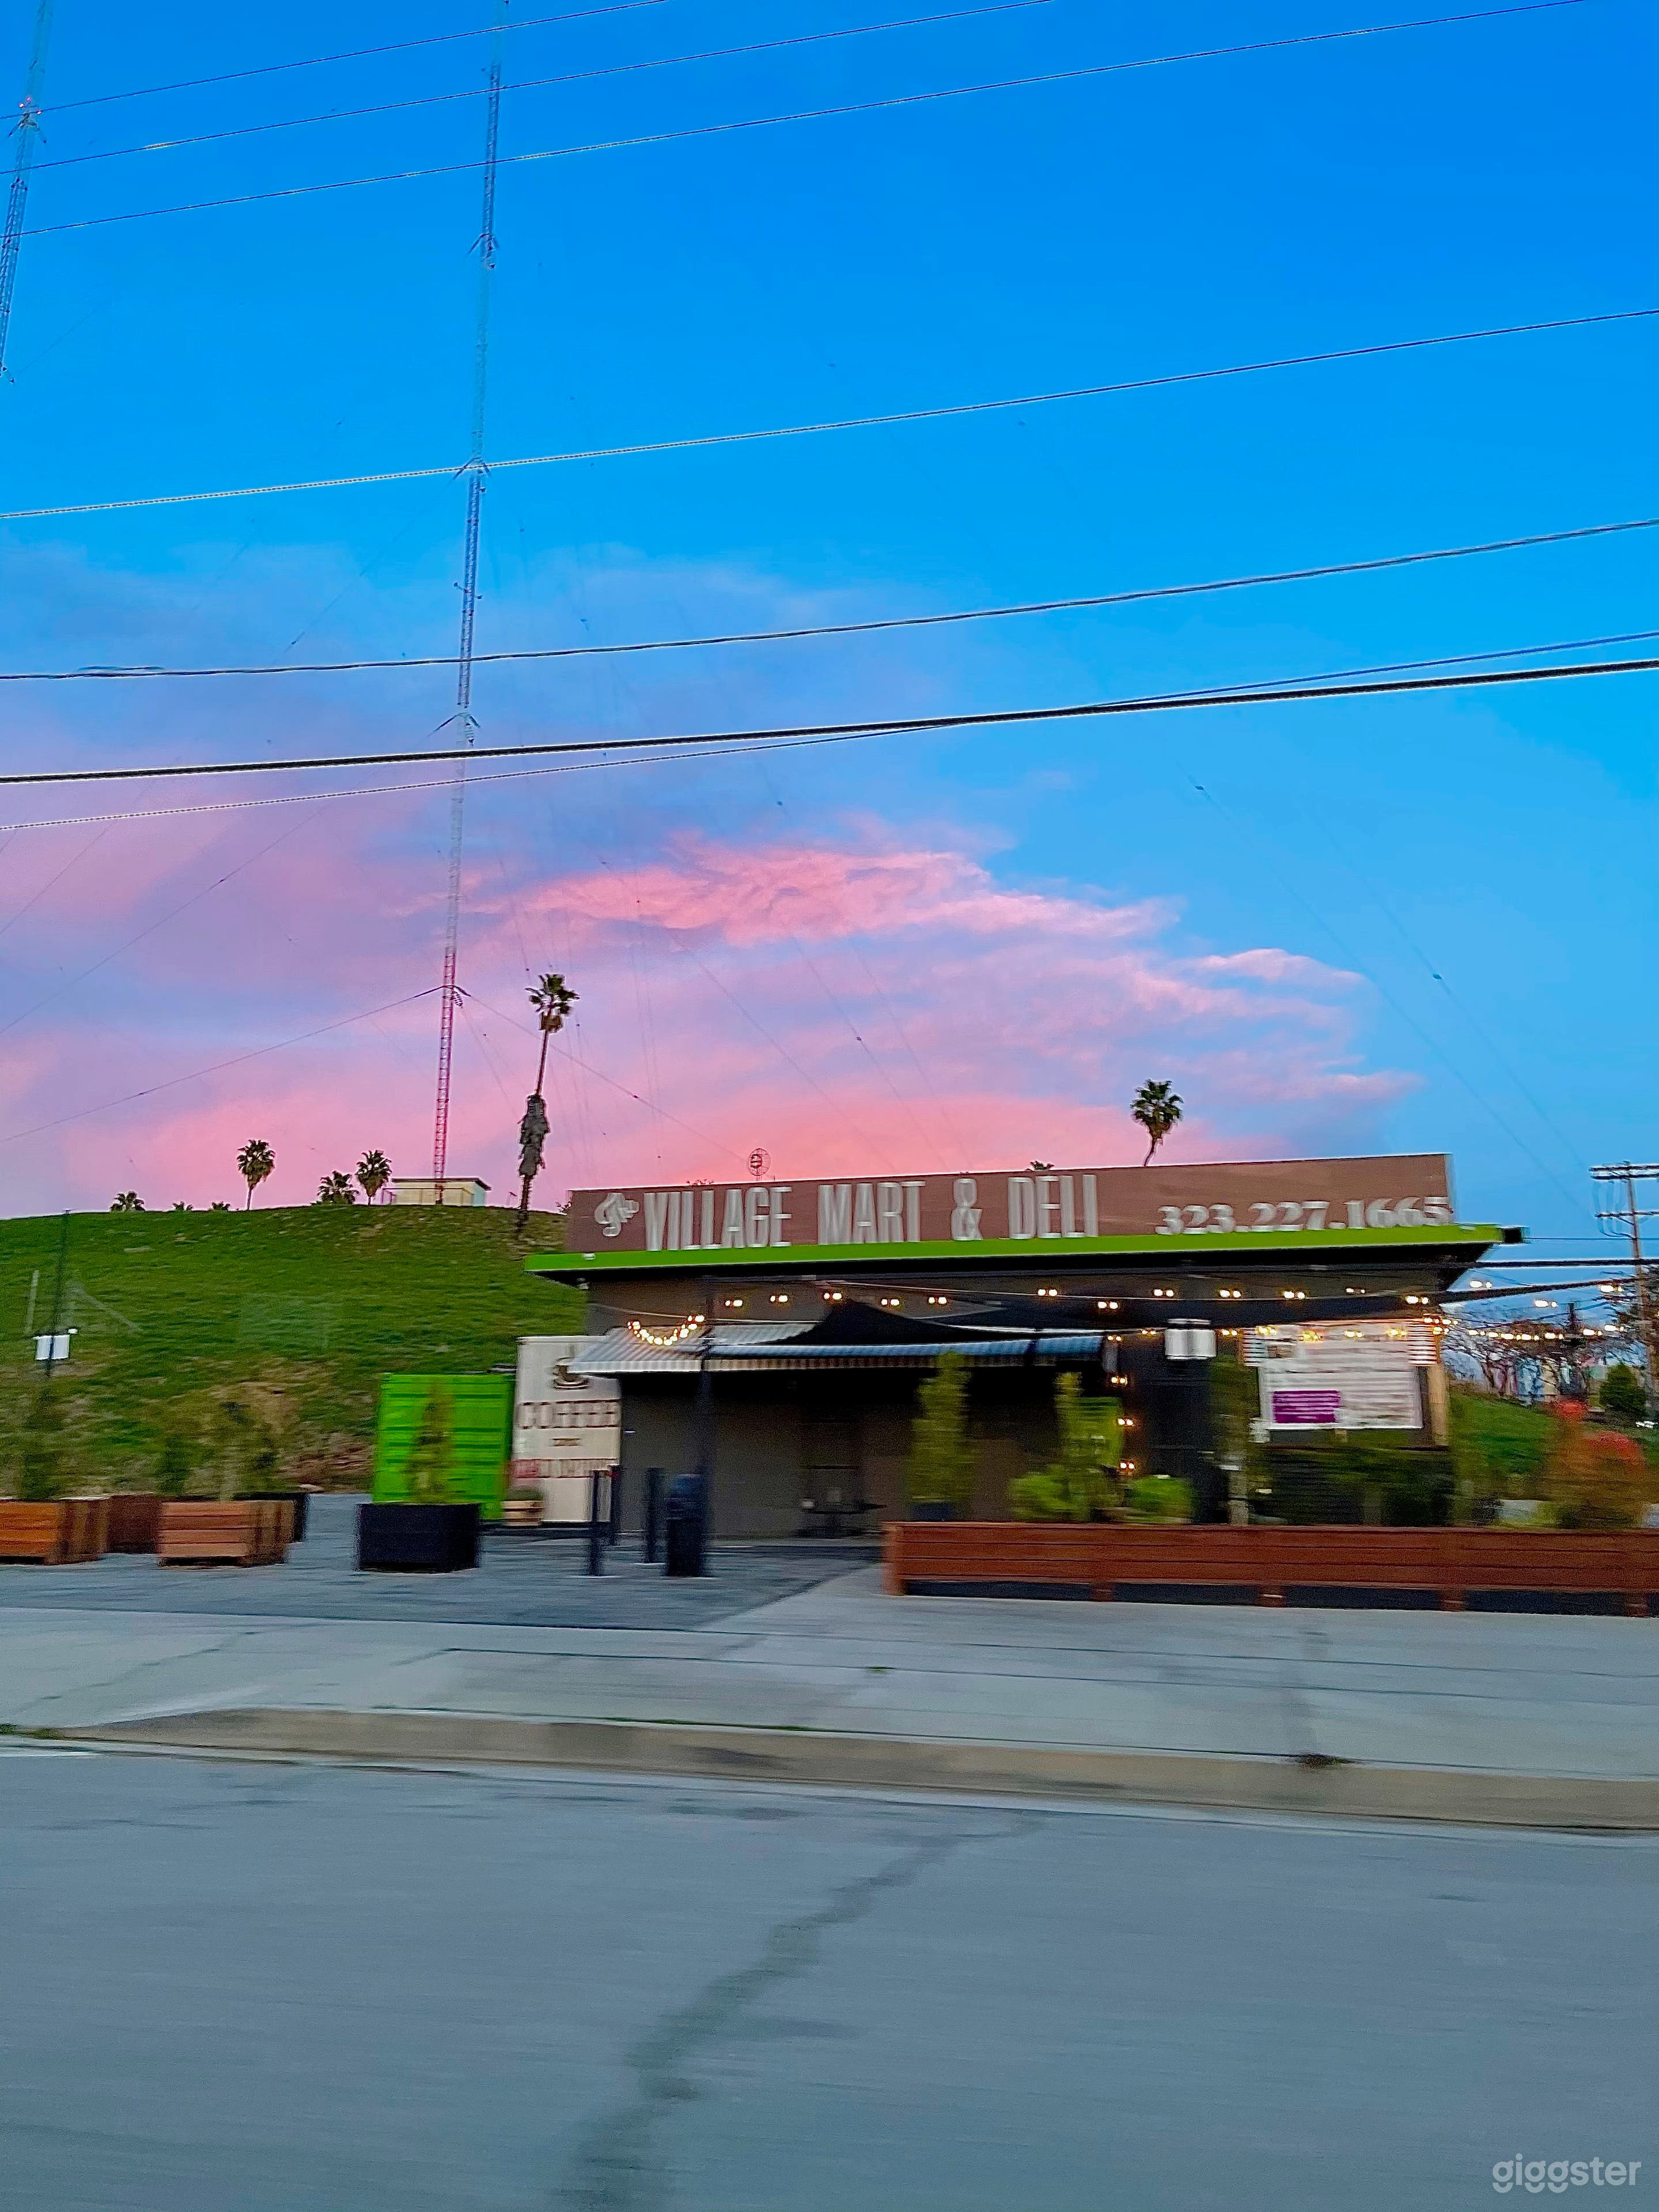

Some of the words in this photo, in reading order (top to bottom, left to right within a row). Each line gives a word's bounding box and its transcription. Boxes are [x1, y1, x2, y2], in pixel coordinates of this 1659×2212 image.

[643, 1187, 793, 1251] VILLAGE
[817, 1180, 926, 1245] MART
[951, 1177, 983, 1241] &
[1007, 1173, 1099, 1240] DELI
[1154, 1196, 1454, 1235] 323.227.1665
